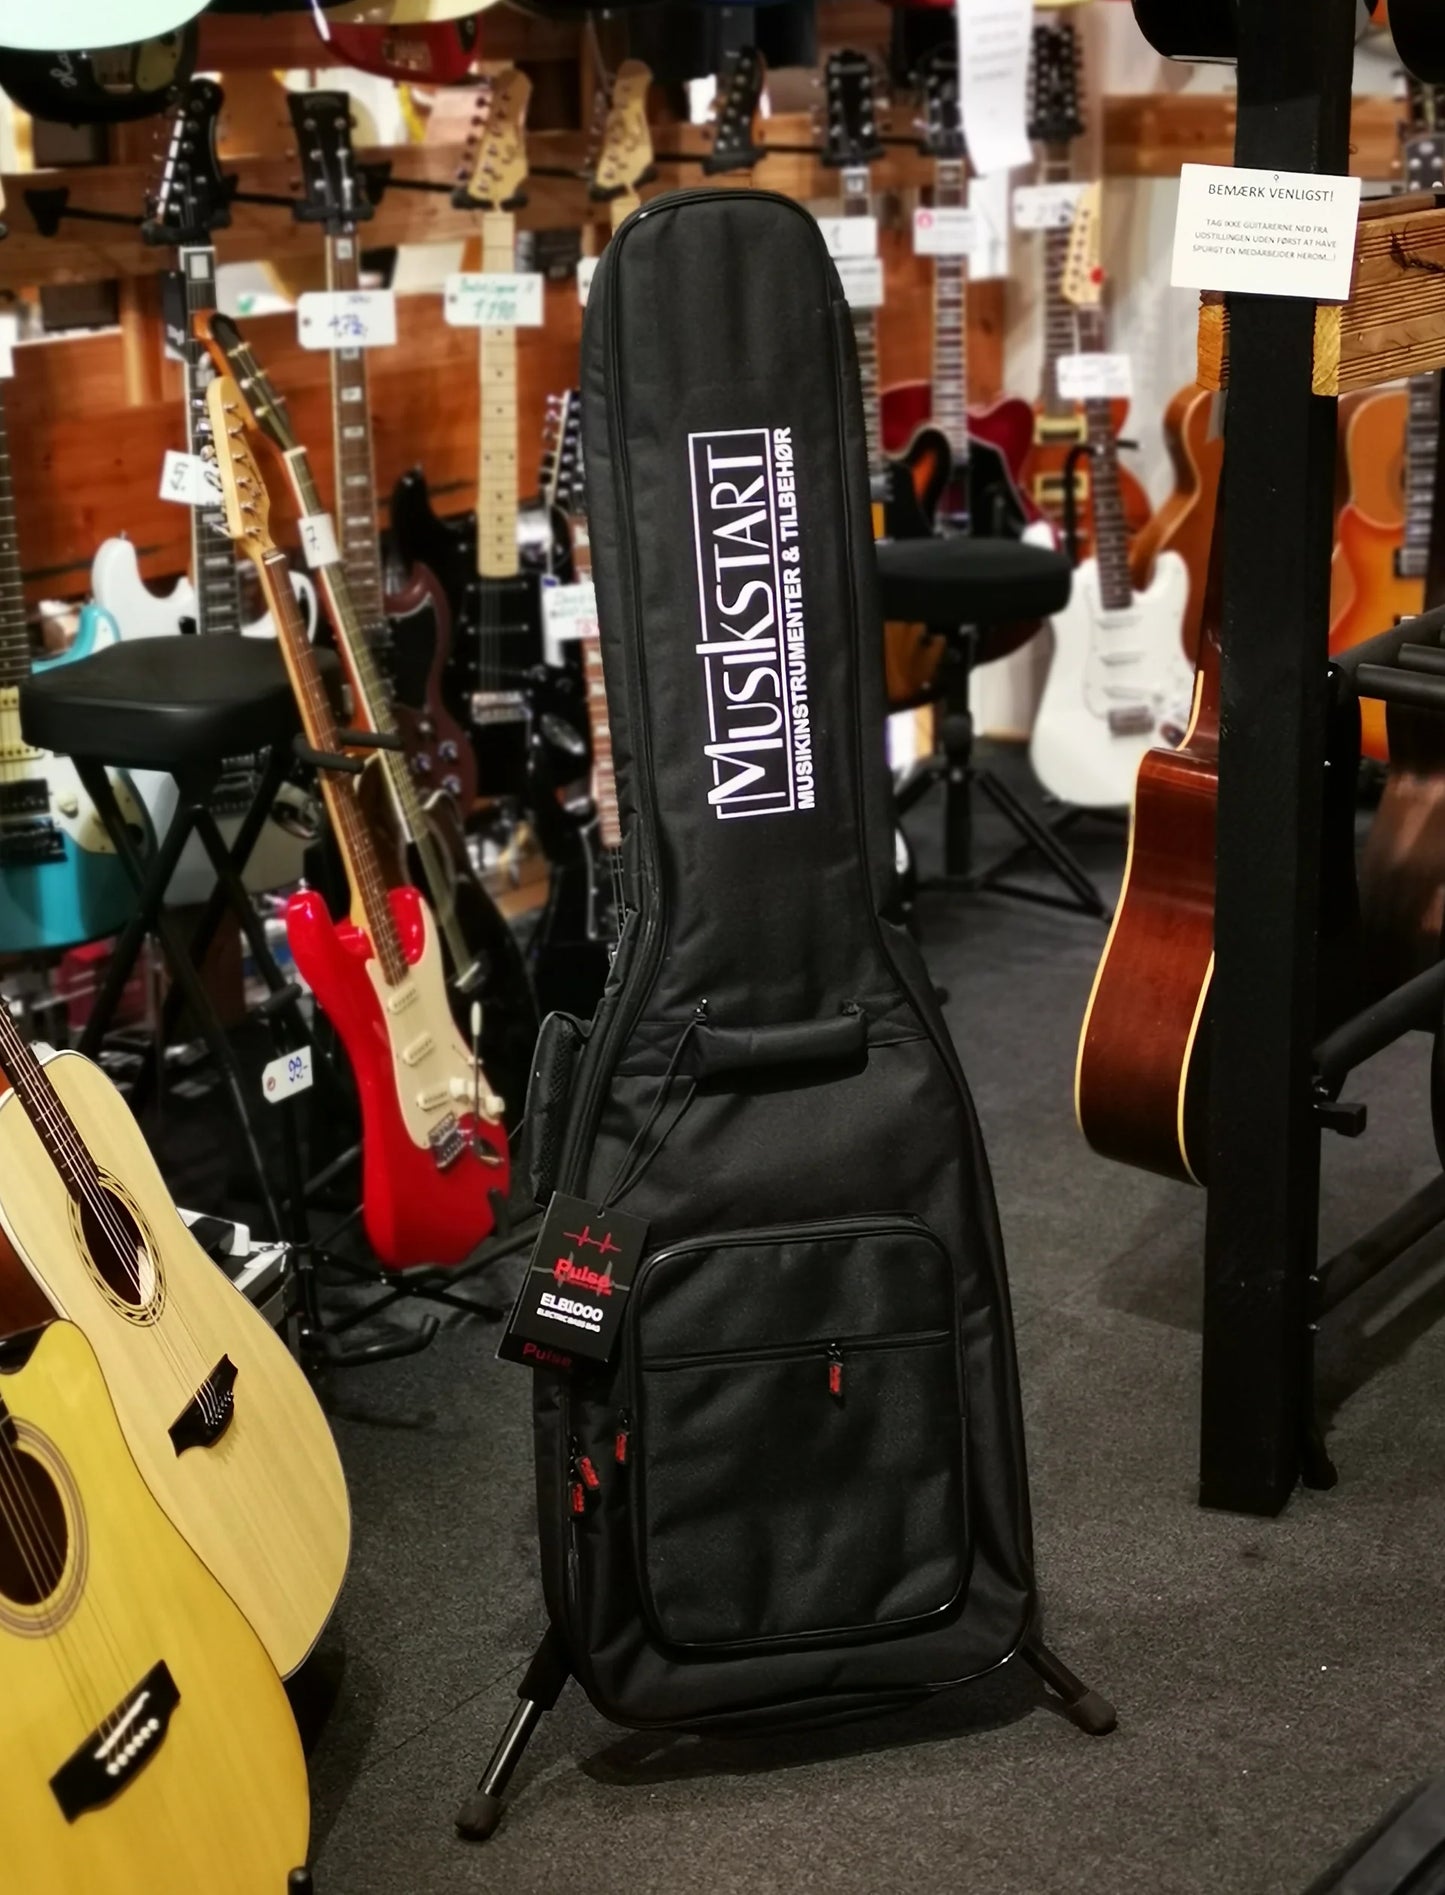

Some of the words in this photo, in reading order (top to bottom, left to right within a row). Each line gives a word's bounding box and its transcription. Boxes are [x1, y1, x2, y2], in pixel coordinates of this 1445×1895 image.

[1208, 184, 1265, 199] BEMÆRK
[1269, 188, 1334, 202] VENLIGST!
[1206, 218, 1222, 227] TAG
[1224, 220, 1241, 229] IKKE
[1243, 221, 1293, 232] GUITARERNE
[1295, 224, 1312, 233] NED
[1313, 226, 1328, 234] FRA
[1194, 231, 1251, 242] UDSTILLINGEN
[1252, 235, 1275, 244] UDEN
[1277, 237, 1301, 246] FØRST
[1303, 239, 1313, 247] AT
[1315, 240, 1337, 249] HAVE
[1192, 244, 1224, 254] SPURGT
[1225, 246, 1236, 255] EN
[1238, 248, 1295, 260] MEDARBEJDER
[773, 427, 799, 543] TILBEHØR
[781, 546, 800, 563] &
[783, 567, 816, 810] MUSIKINSTRUMENTER
[554, 1258, 613, 1289] Pulse
[522, 1342, 573, 1367] Pulse
